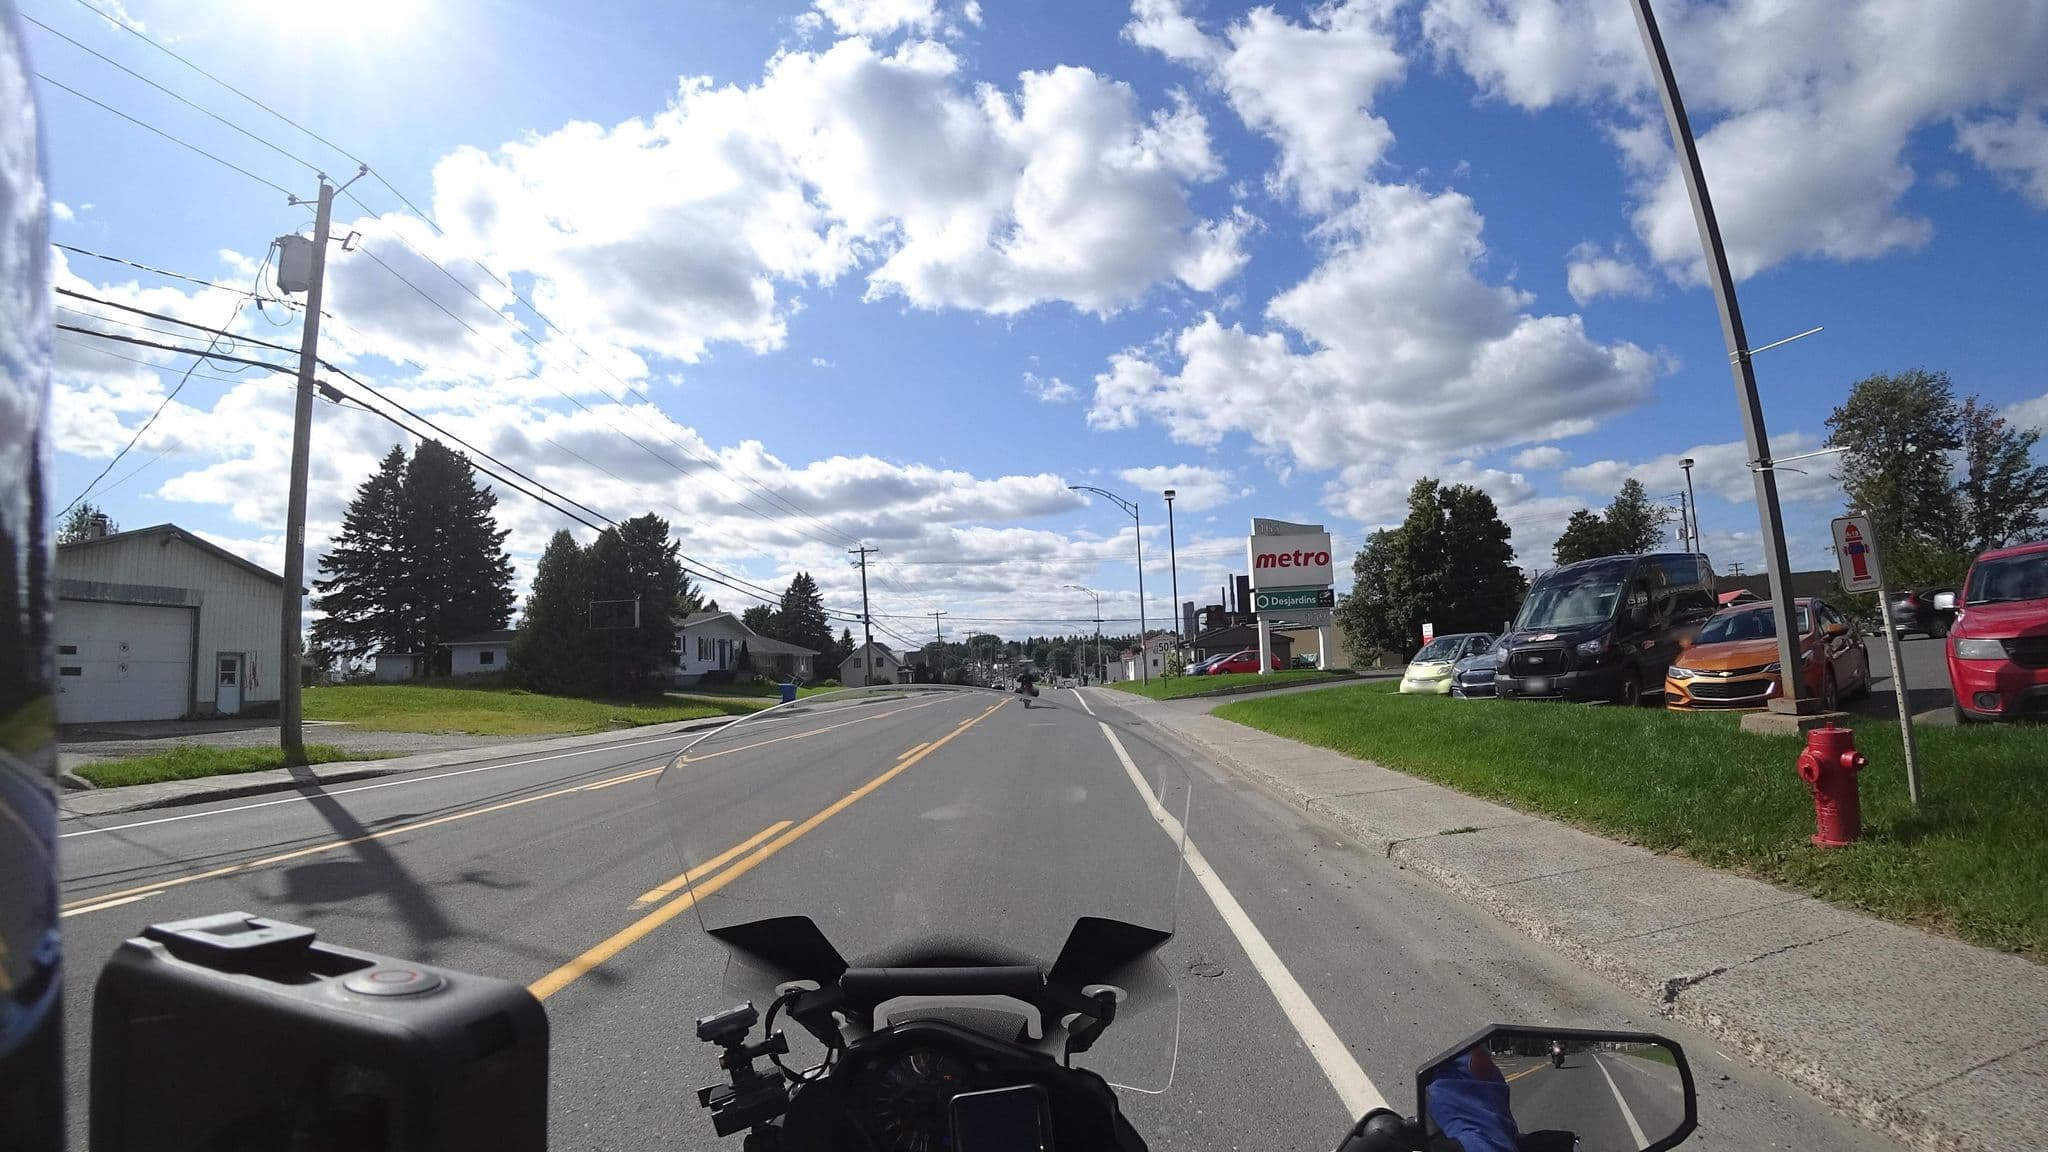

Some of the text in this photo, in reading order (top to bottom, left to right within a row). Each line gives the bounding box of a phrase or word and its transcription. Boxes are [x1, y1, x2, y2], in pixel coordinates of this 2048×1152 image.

[1257, 550, 1330, 569] metro
[1271, 595, 1317, 607] Desjardins
[1159, 642, 1169, 652] 50
